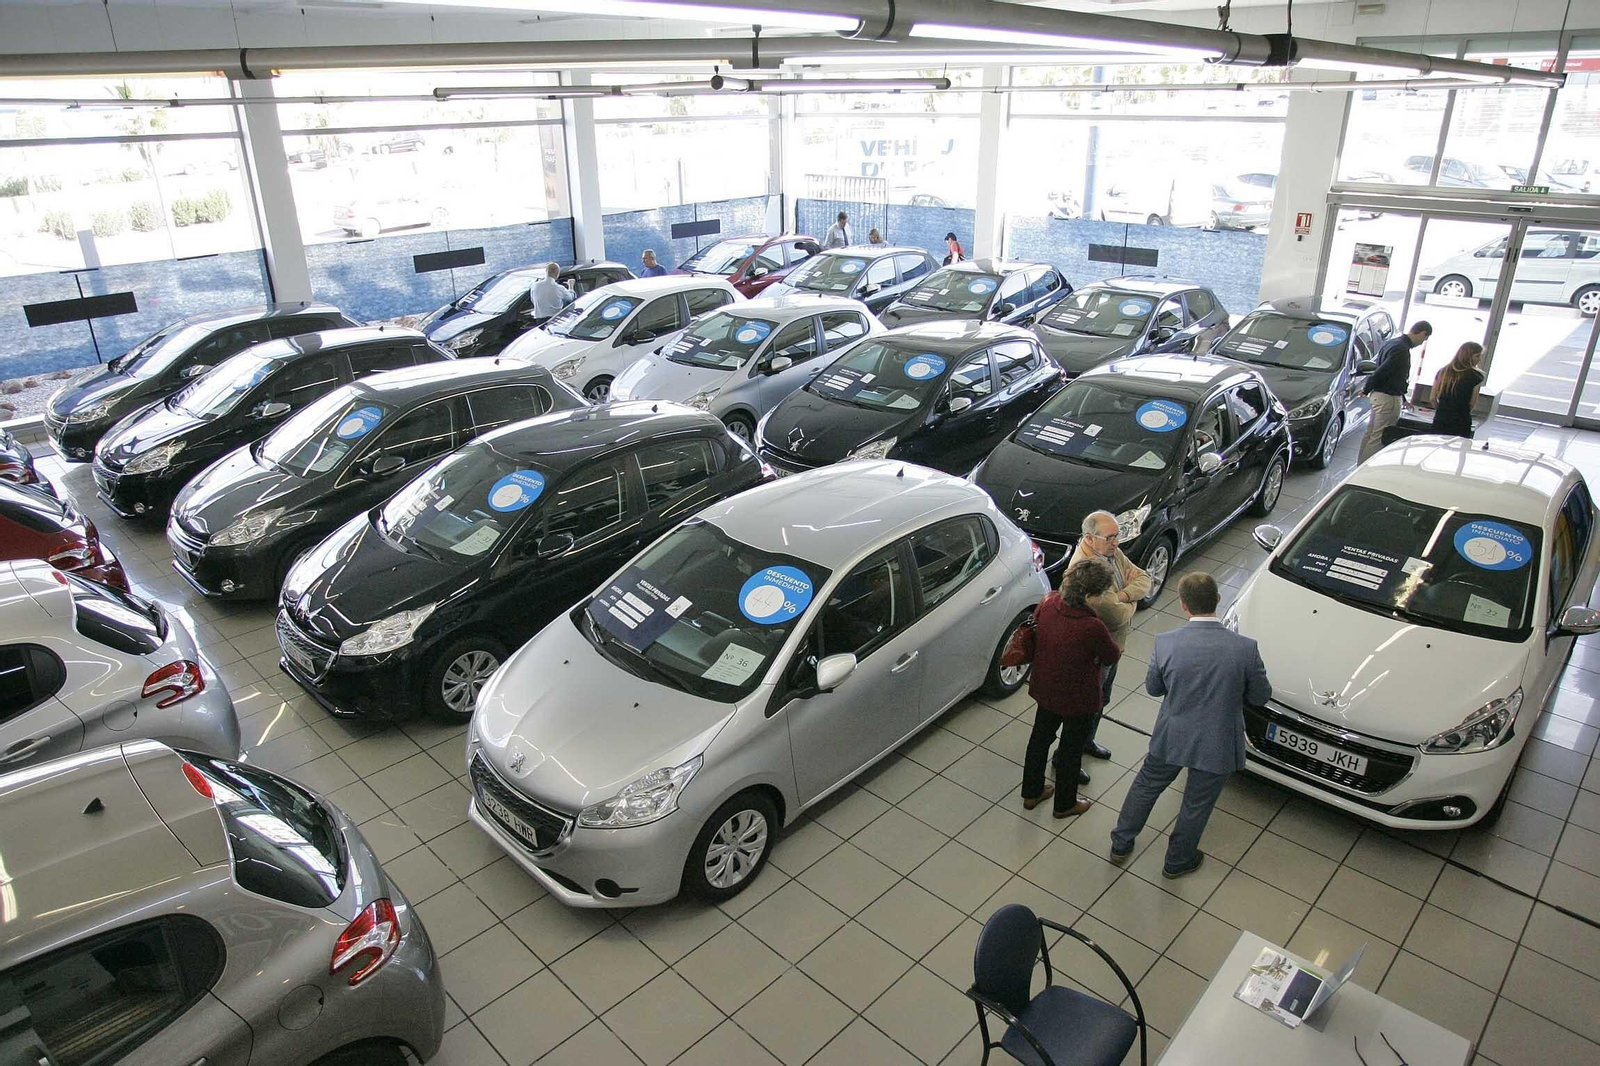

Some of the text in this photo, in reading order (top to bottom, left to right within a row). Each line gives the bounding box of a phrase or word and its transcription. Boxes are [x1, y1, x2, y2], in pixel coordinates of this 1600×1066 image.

[512, 472, 543, 486] DESCUENTO
[1471, 523, 1524, 542] DESCUENTO
[1471, 529, 1521, 545] INMEDIATO
[1343, 545, 1399, 564] VENTAS PRIVADAS
[1506, 550, 1522, 562] %
[763, 575, 804, 594] INMEDIATO
[766, 569, 810, 590] DESCUENTO
[783, 600, 796, 614] %
[737, 658, 749, 667] 36
[1279, 729, 1359, 771] 5939 JKH
